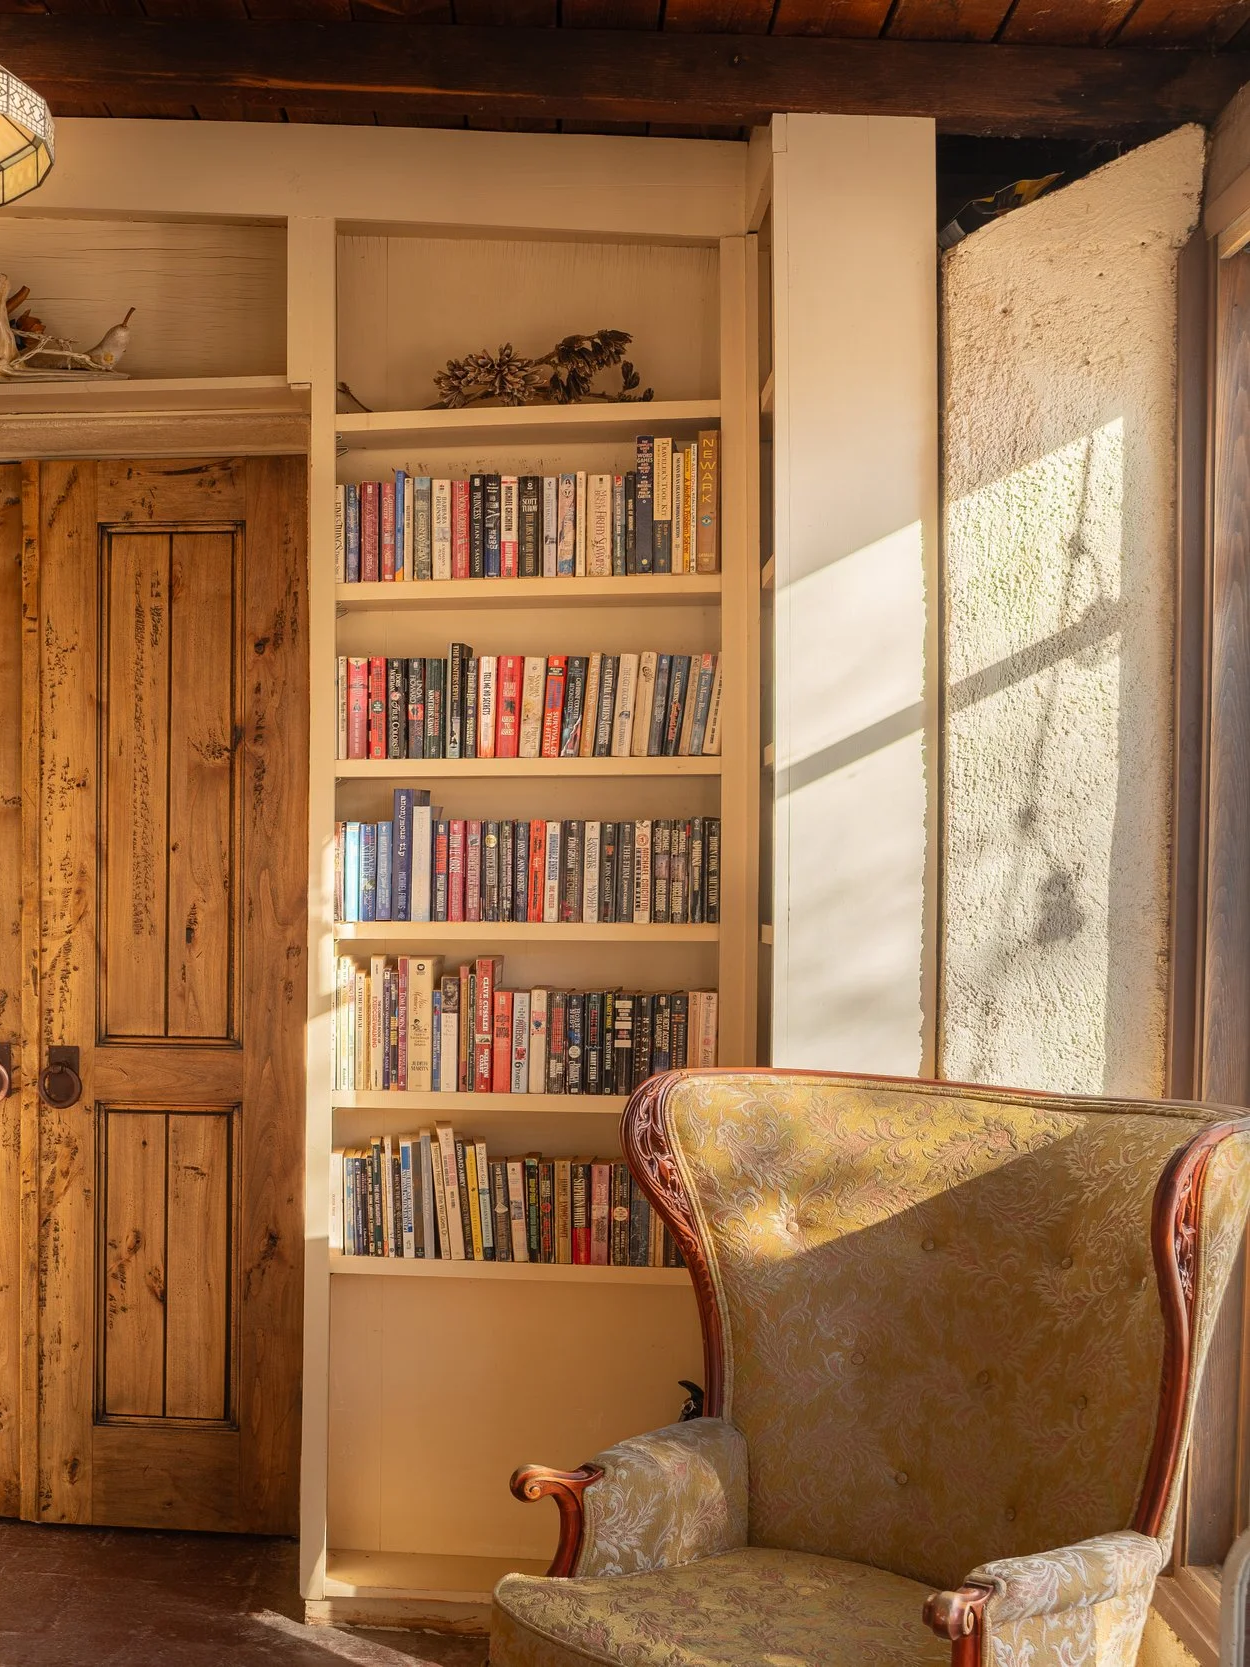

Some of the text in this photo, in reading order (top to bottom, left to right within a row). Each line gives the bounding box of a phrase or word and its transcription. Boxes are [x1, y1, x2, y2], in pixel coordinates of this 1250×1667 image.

[700, 439, 716, 502] NEWARK
[473, 492, 481, 519] PRINCESS
[551, 711, 559, 745] SURVIVAL
[515, 1019, 524, 1047] PATTERSON
[641, 1018, 649, 1071] MOSAIC
